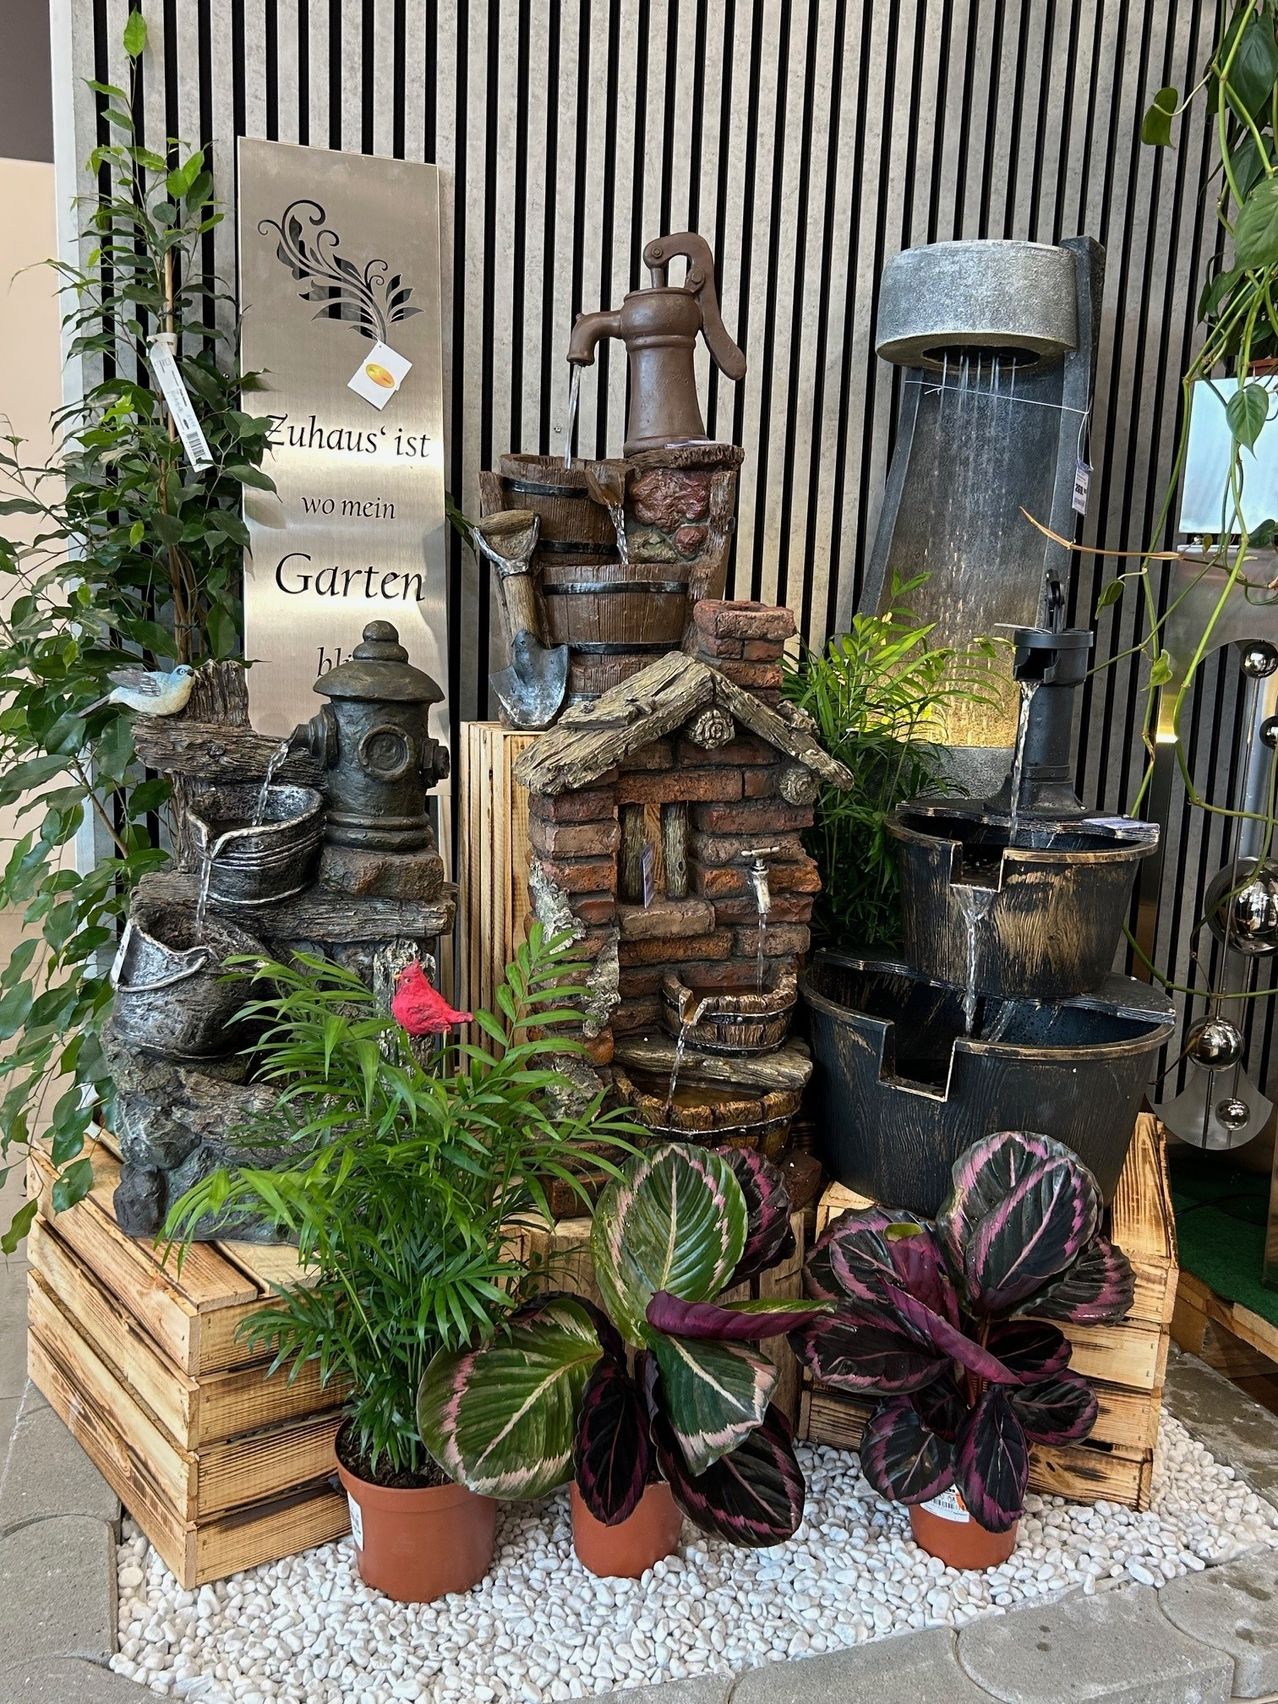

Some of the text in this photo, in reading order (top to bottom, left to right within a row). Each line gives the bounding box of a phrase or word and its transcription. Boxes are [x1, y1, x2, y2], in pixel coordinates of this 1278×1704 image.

[394, 428, 431, 458] ist
[301, 496, 395, 519] wo mein
[275, 552, 425, 602] Garten
